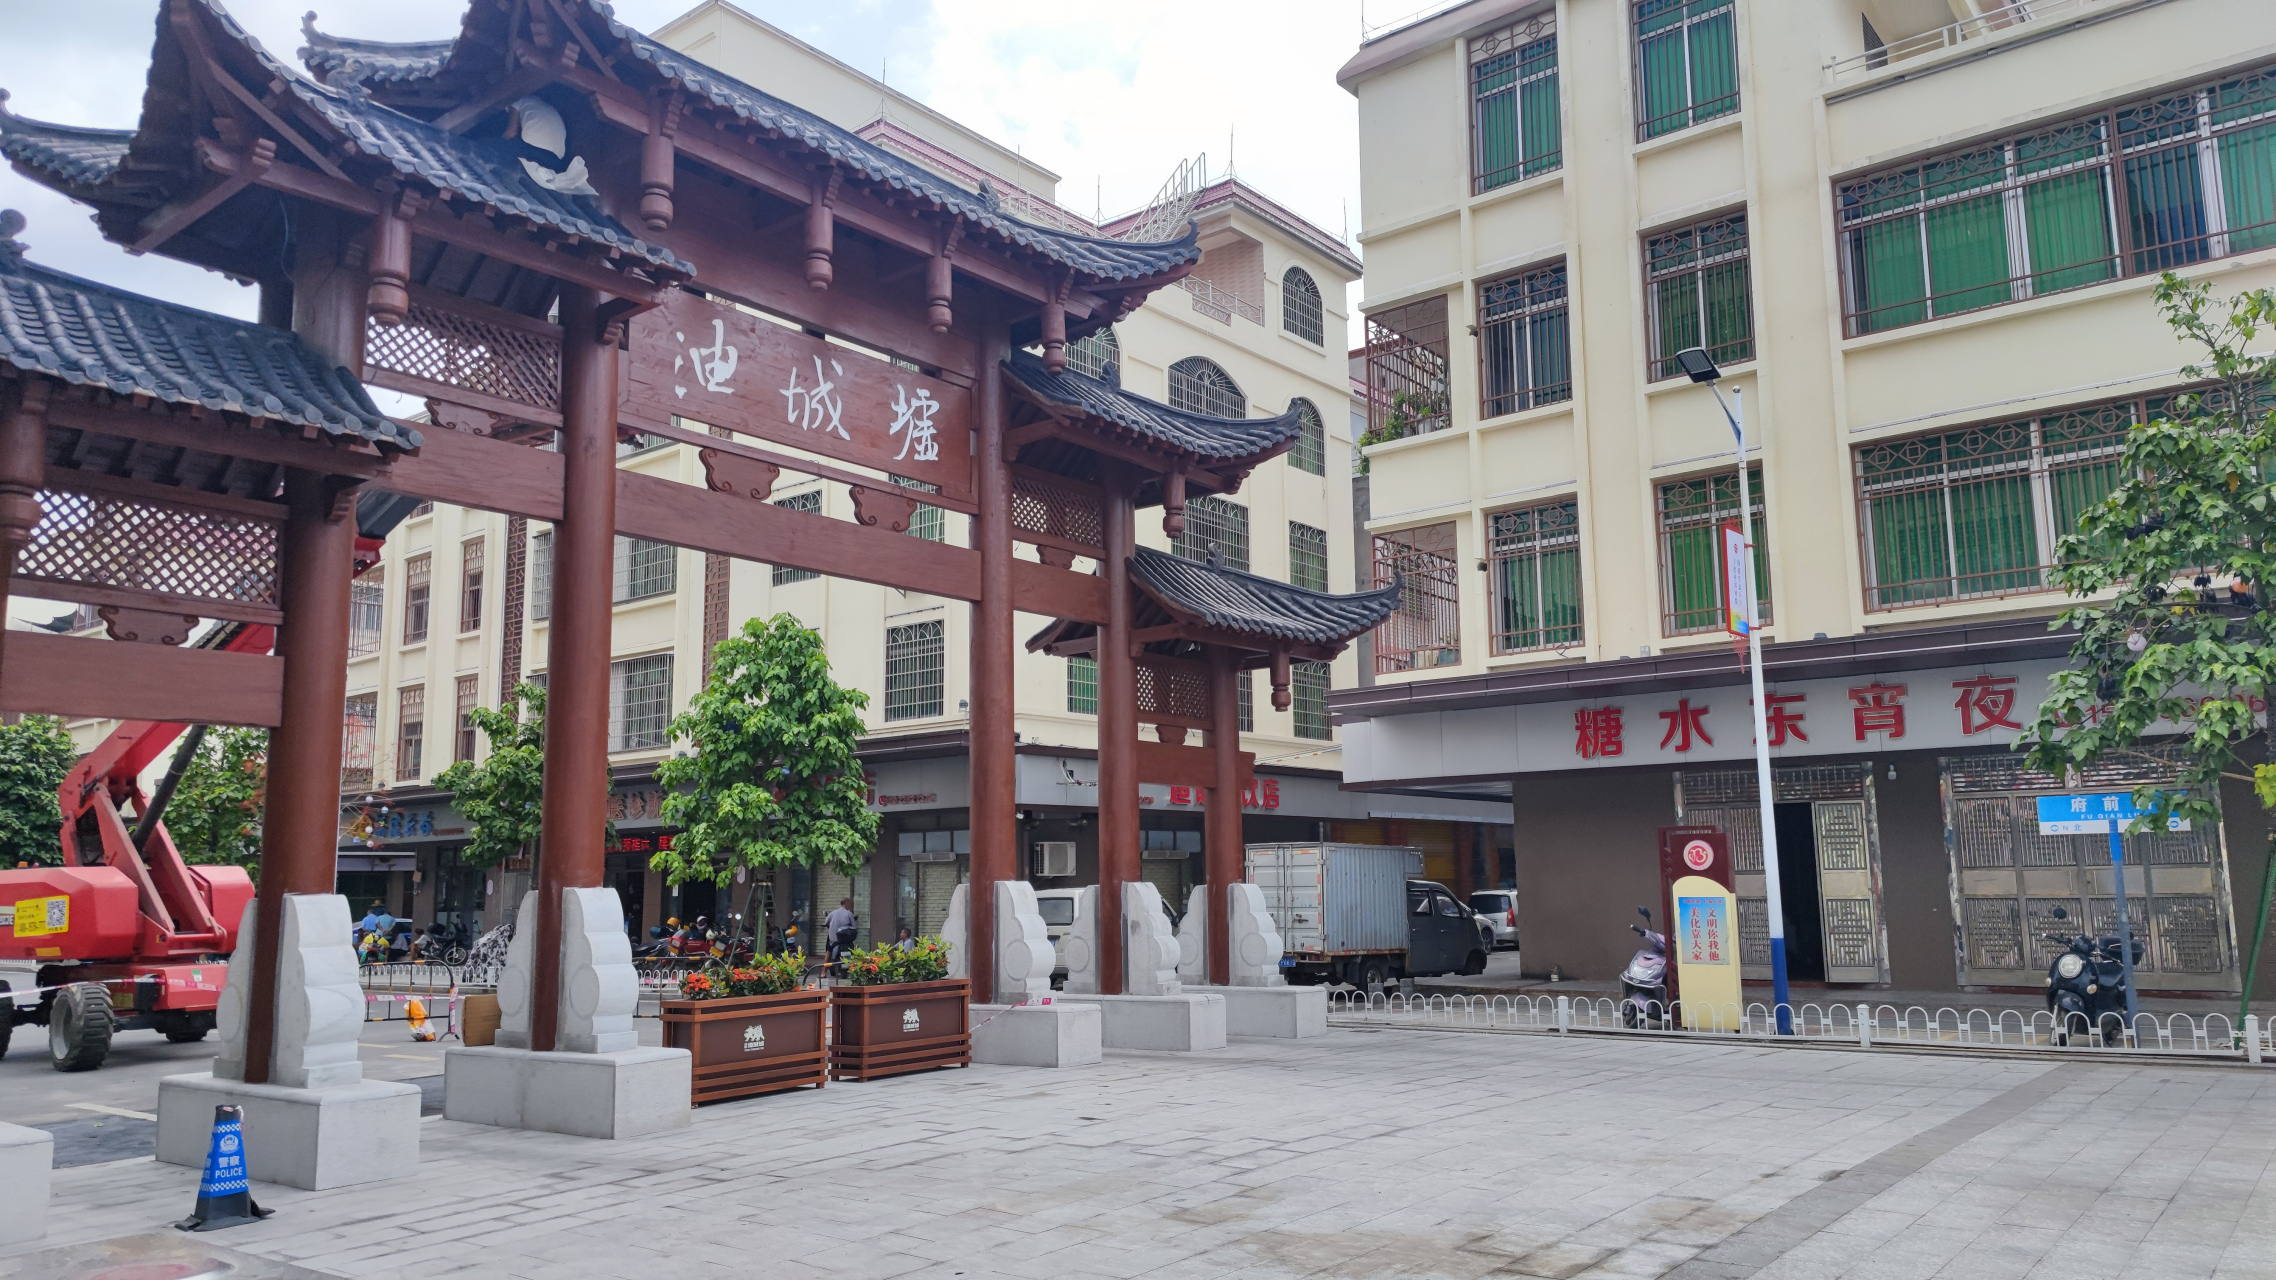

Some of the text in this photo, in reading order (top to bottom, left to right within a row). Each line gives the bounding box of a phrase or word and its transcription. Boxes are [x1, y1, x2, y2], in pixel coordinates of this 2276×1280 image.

[1574, 673, 2022, 760] 糖水东宵夜
[1690, 907, 1703, 961] 美化靠大家
[1707, 907, 1720, 961] 文明你我他
[215, 1166, 243, 1179] POLICE
[218, 1156, 240, 1168] 警察
